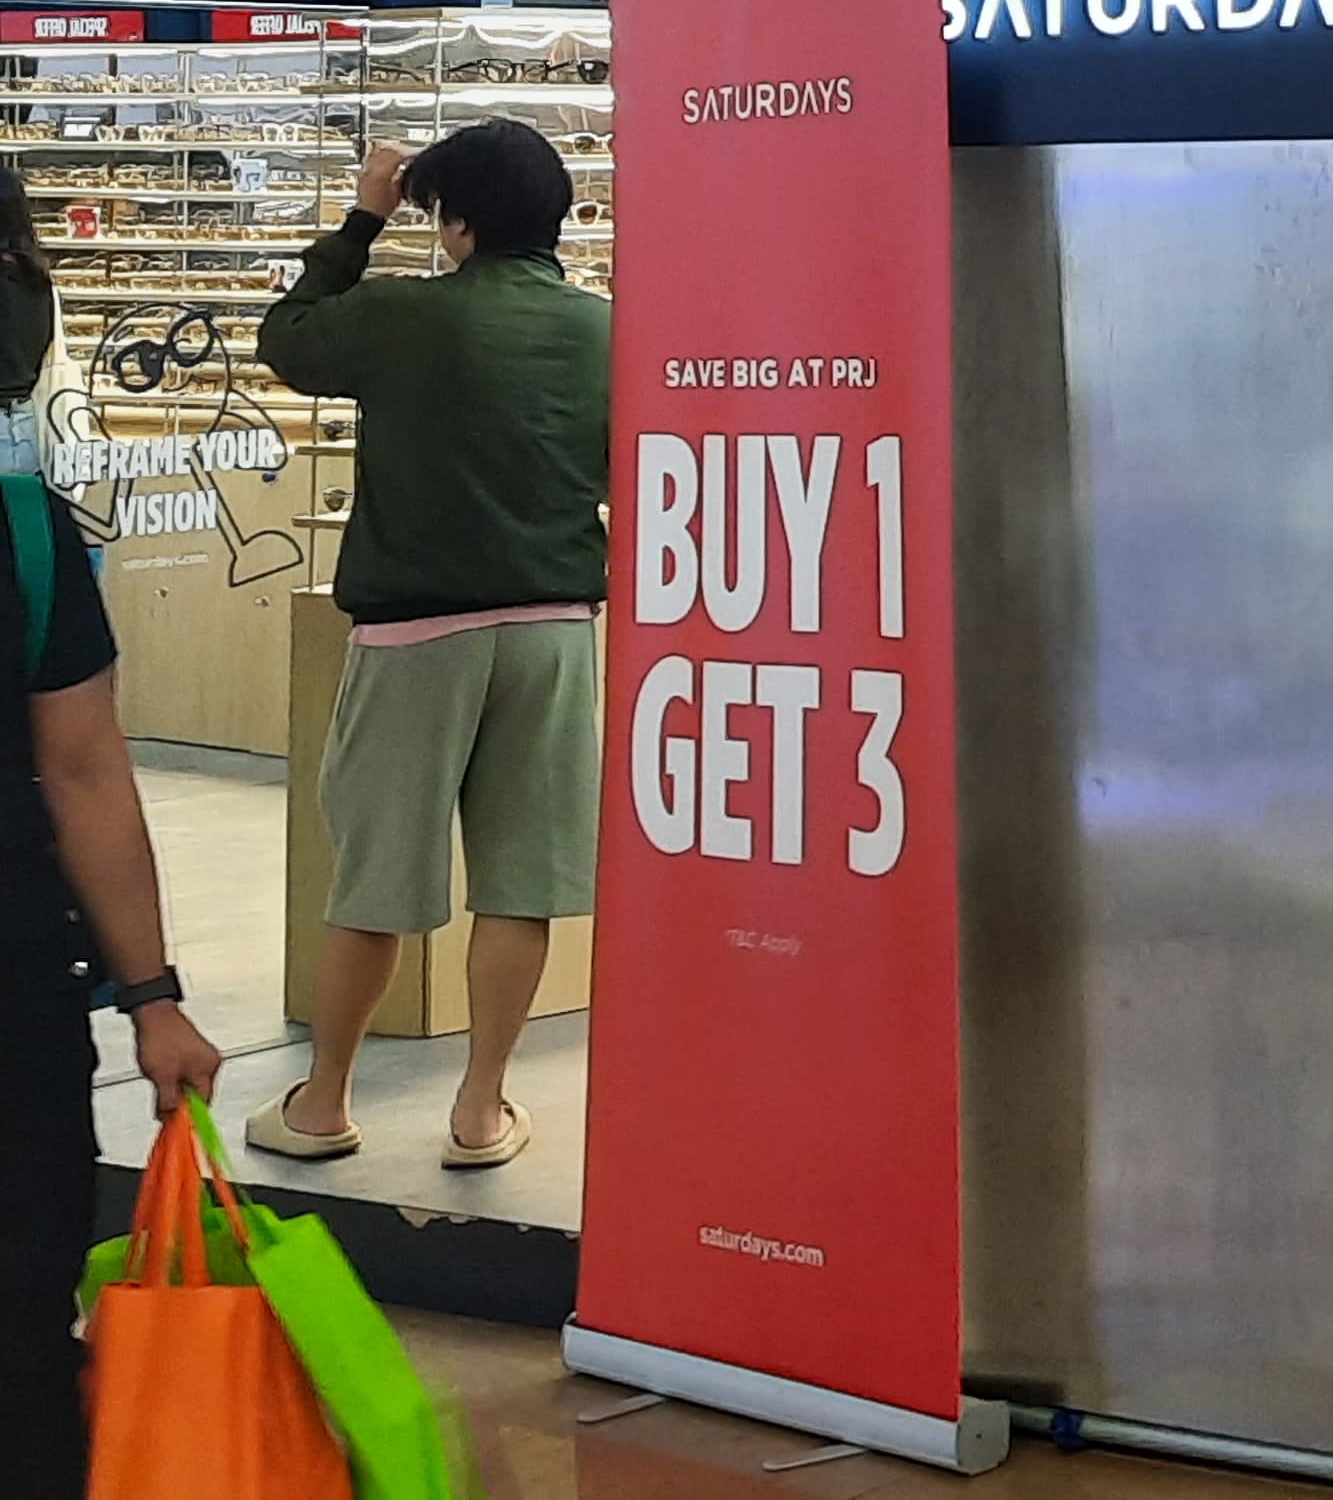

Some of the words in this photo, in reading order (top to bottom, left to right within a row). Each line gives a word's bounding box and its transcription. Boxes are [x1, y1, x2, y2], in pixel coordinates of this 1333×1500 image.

[683, 78, 852, 123] SATURDAYS
[665, 359, 726, 388] SAVE
[733, 359, 779, 388] BIG
[788, 358, 825, 388] AT
[832, 358, 876, 388] PRJ
[51, 435, 192, 485] REFRAME
[198, 429, 279, 472] YOUR
[116, 489, 218, 538] VISION
[636, 433, 842, 633] BUY
[866, 435, 904, 639] 1
[631, 655, 821, 865] GET
[848, 669, 905, 876] 3
[700, 1226, 824, 1266] saturdays.com
